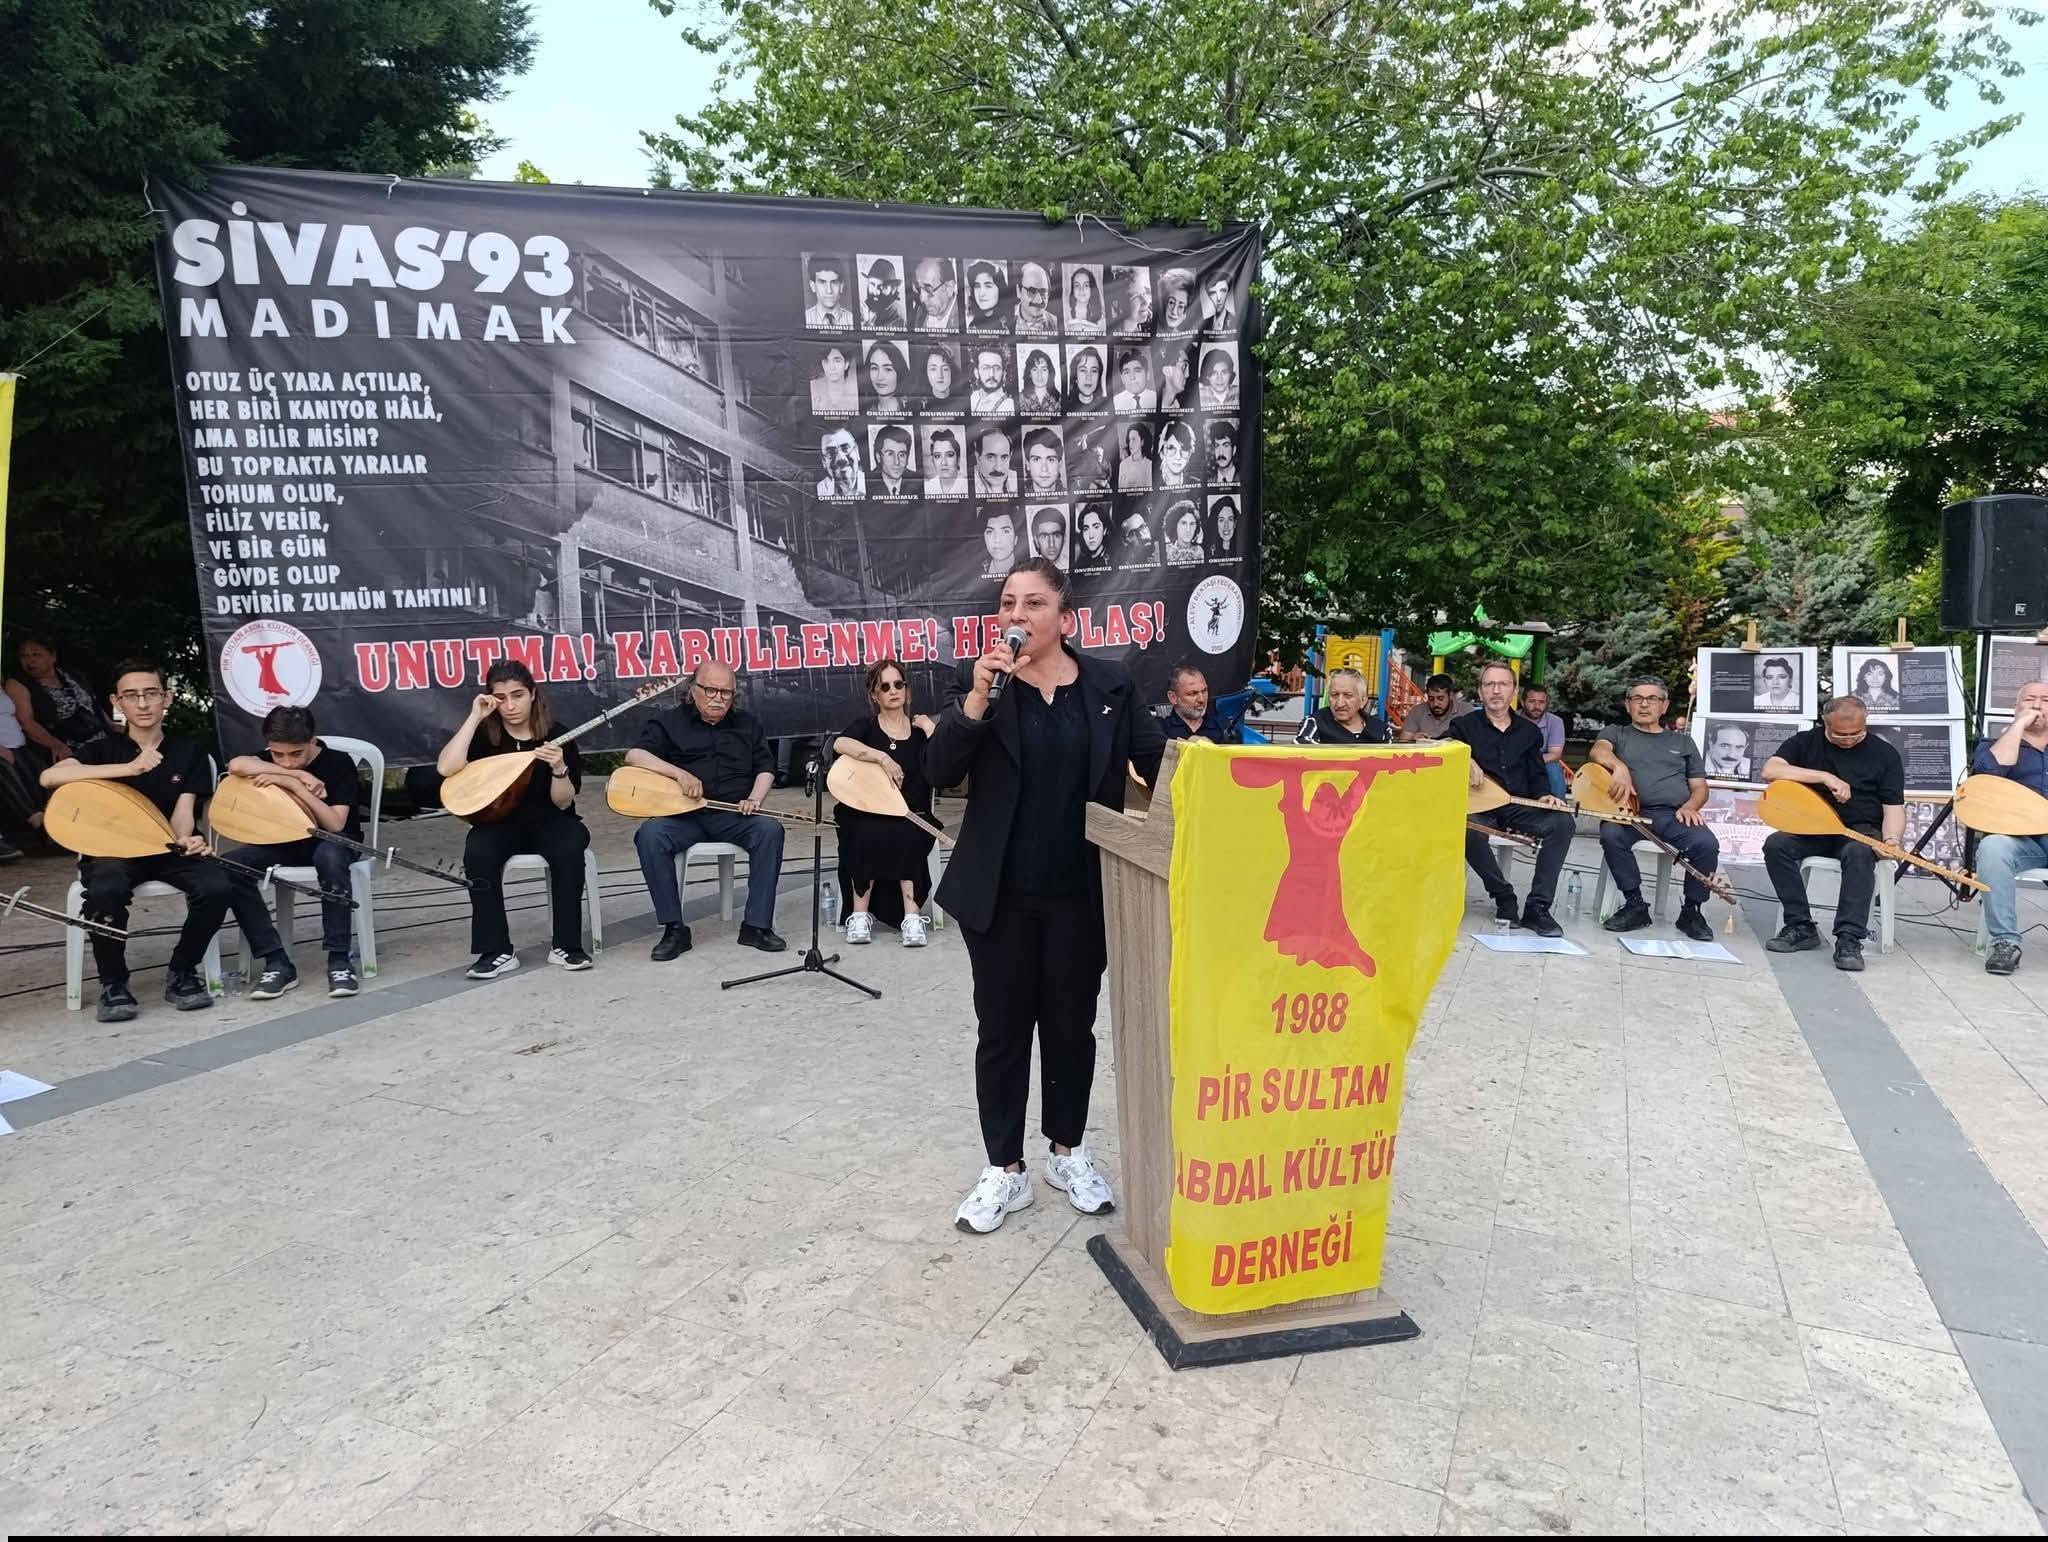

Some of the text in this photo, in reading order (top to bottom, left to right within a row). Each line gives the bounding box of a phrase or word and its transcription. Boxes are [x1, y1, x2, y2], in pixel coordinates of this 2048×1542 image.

[172, 200, 576, 297] SİVAS'93
[179, 298, 577, 345] MADIMAK
[186, 368, 430, 397] OTUZ ÜÇ YARA AÇTILAR,
[189, 395, 443, 423] HER BİRİ KANIYOR HÂLÂ,
[194, 423, 379, 449] AMA BİLİR MİSİN?
[197, 454, 428, 477] BU TOPRAKTA YARALAR
[200, 483, 344, 505] TOHUM OLUR,
[206, 506, 330, 533] FİLİZ VERİR,
[208, 534, 327, 560] VE BİR GÜN
[213, 563, 341, 588] GÖVDE OLUP
[216, 589, 296, 615] DEVİRİR
[301, 586, 387, 611] ZULMÜN
[393, 587, 472, 608] TAHTINI
[353, 600, 1166, 693] UNUTMA! KABULLENME! HELAŞ!
[1271, 992, 1348, 1034] 1988
[1197, 1062, 1391, 1122] PİR SULTAN
[1211, 1210, 1353, 1287] DERNEĞİ
